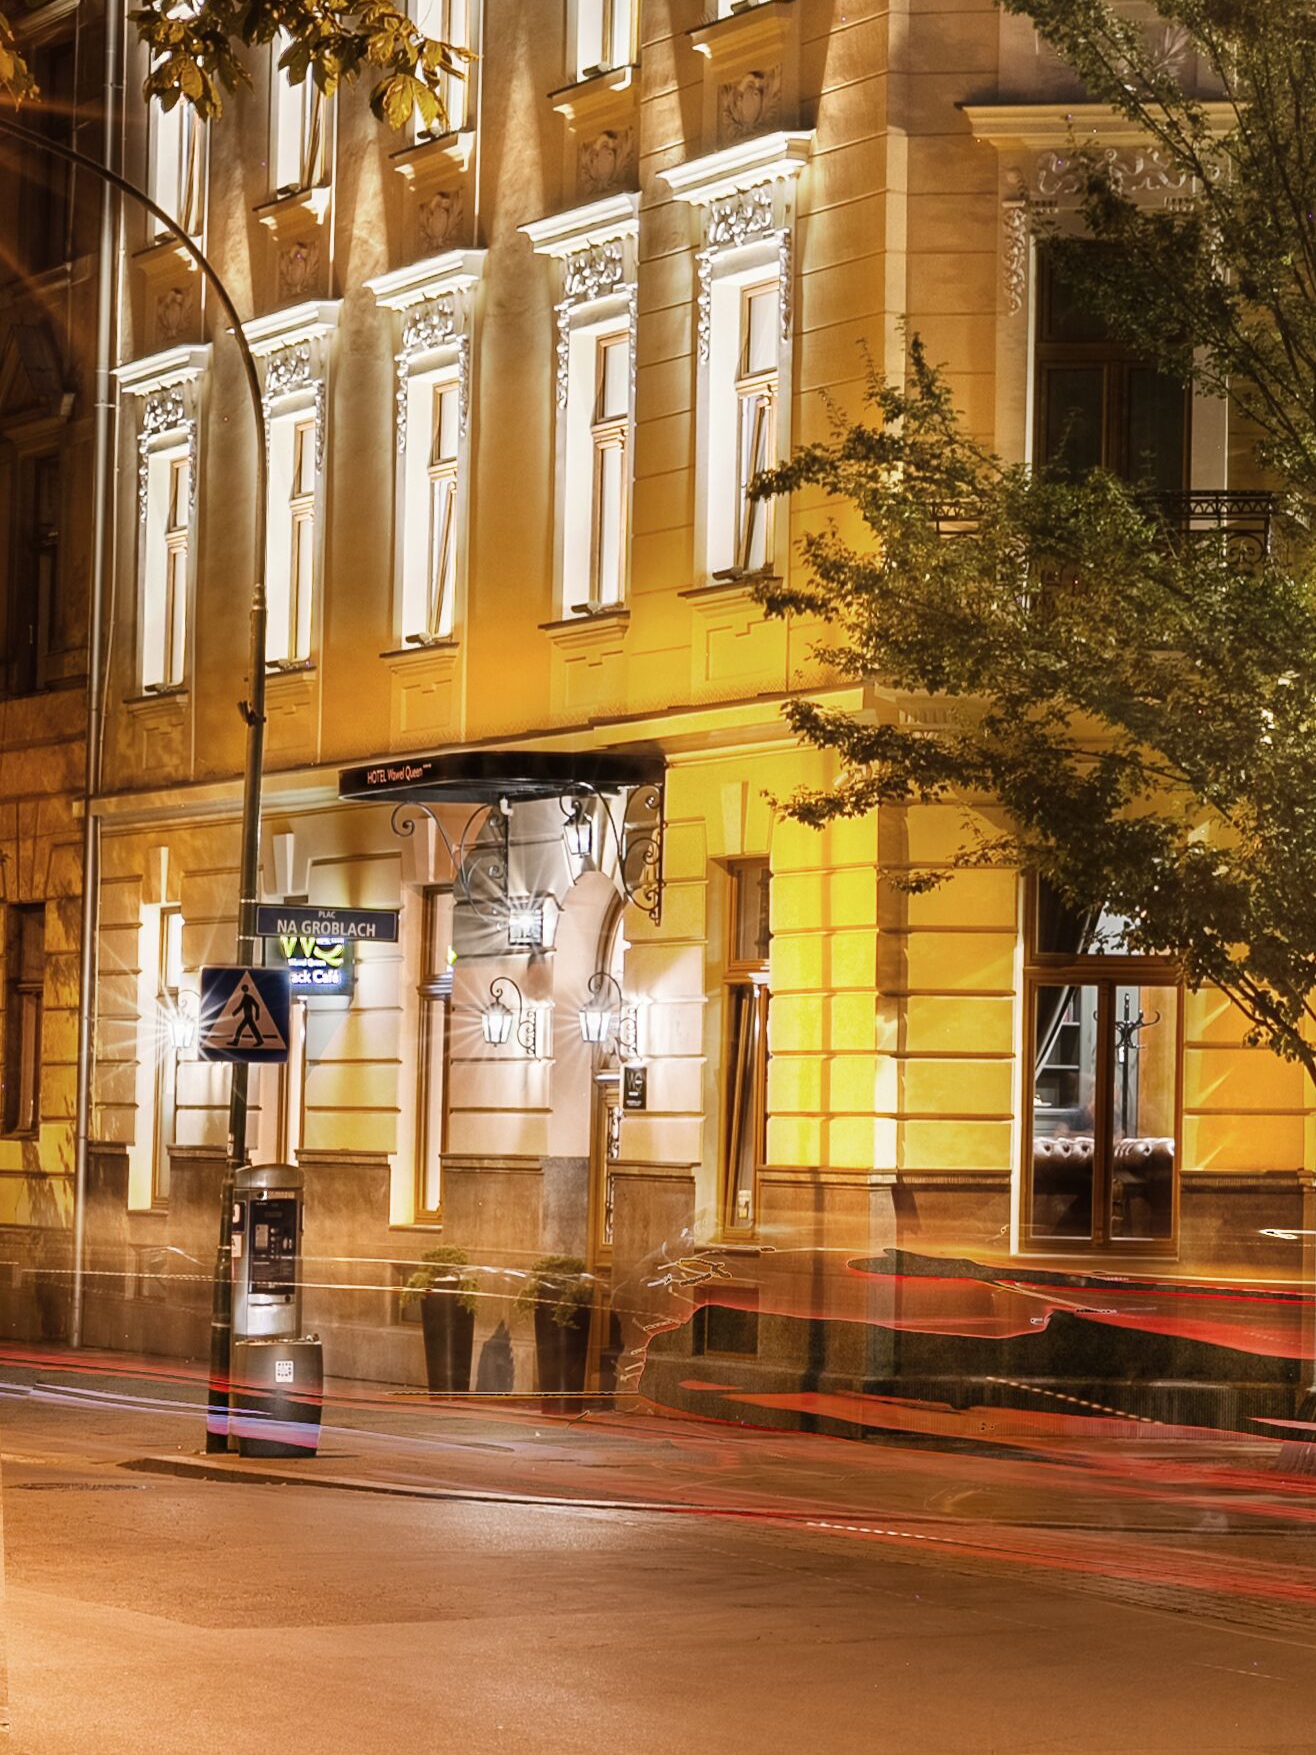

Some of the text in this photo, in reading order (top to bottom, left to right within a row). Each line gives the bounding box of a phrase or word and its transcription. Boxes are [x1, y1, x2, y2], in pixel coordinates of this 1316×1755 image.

[367, 769, 387, 784] HOTEL
[405, 765, 423, 781] Queen
[318, 910, 335, 918] PLAC
[277, 919, 376, 938] NA GROBLACH
